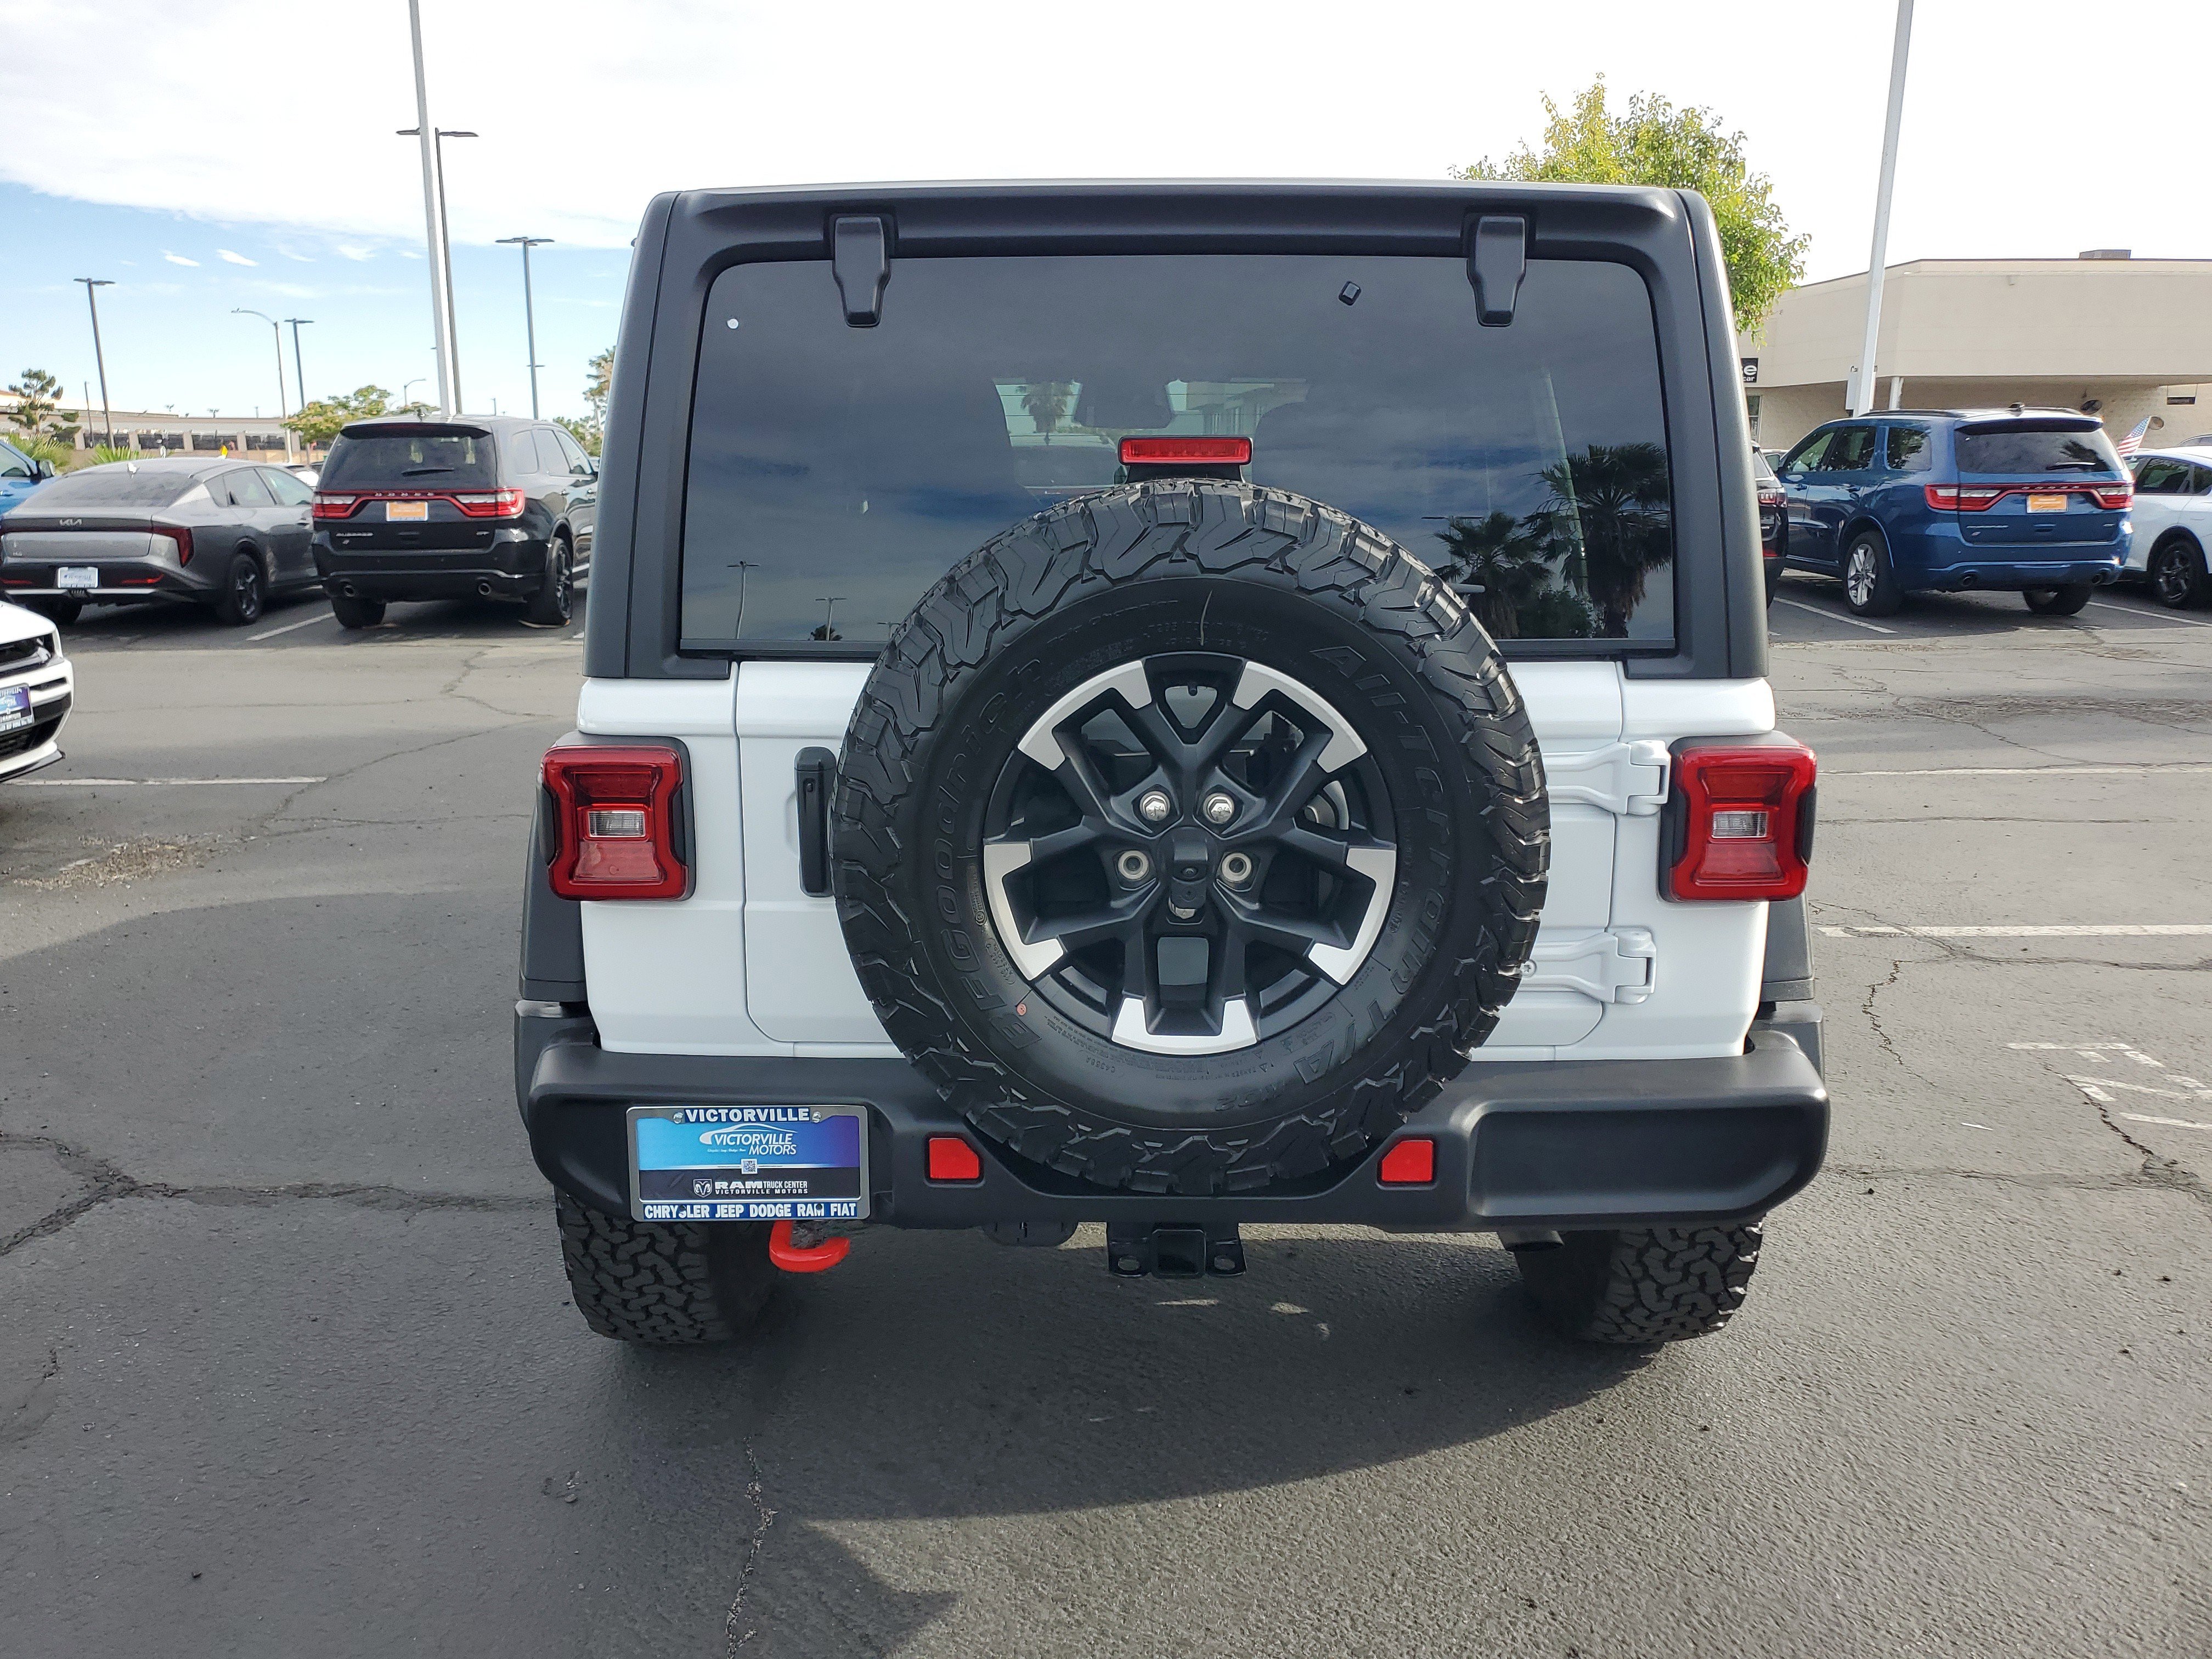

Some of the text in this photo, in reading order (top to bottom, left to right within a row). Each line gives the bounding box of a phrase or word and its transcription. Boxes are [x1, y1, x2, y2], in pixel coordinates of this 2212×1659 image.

[1741, 365, 1757, 376] e
[686, 1108, 809, 1122] VICTORVILLE
[715, 1133, 793, 1146] VICTORVILLE
[749, 1144, 797, 1155] MOTORS
[715, 1204, 744, 1217] JEEP
[749, 1204, 792, 1217] DODGE
[797, 1204, 825, 1216] RAM
[830, 1203, 856, 1216] FIAT
